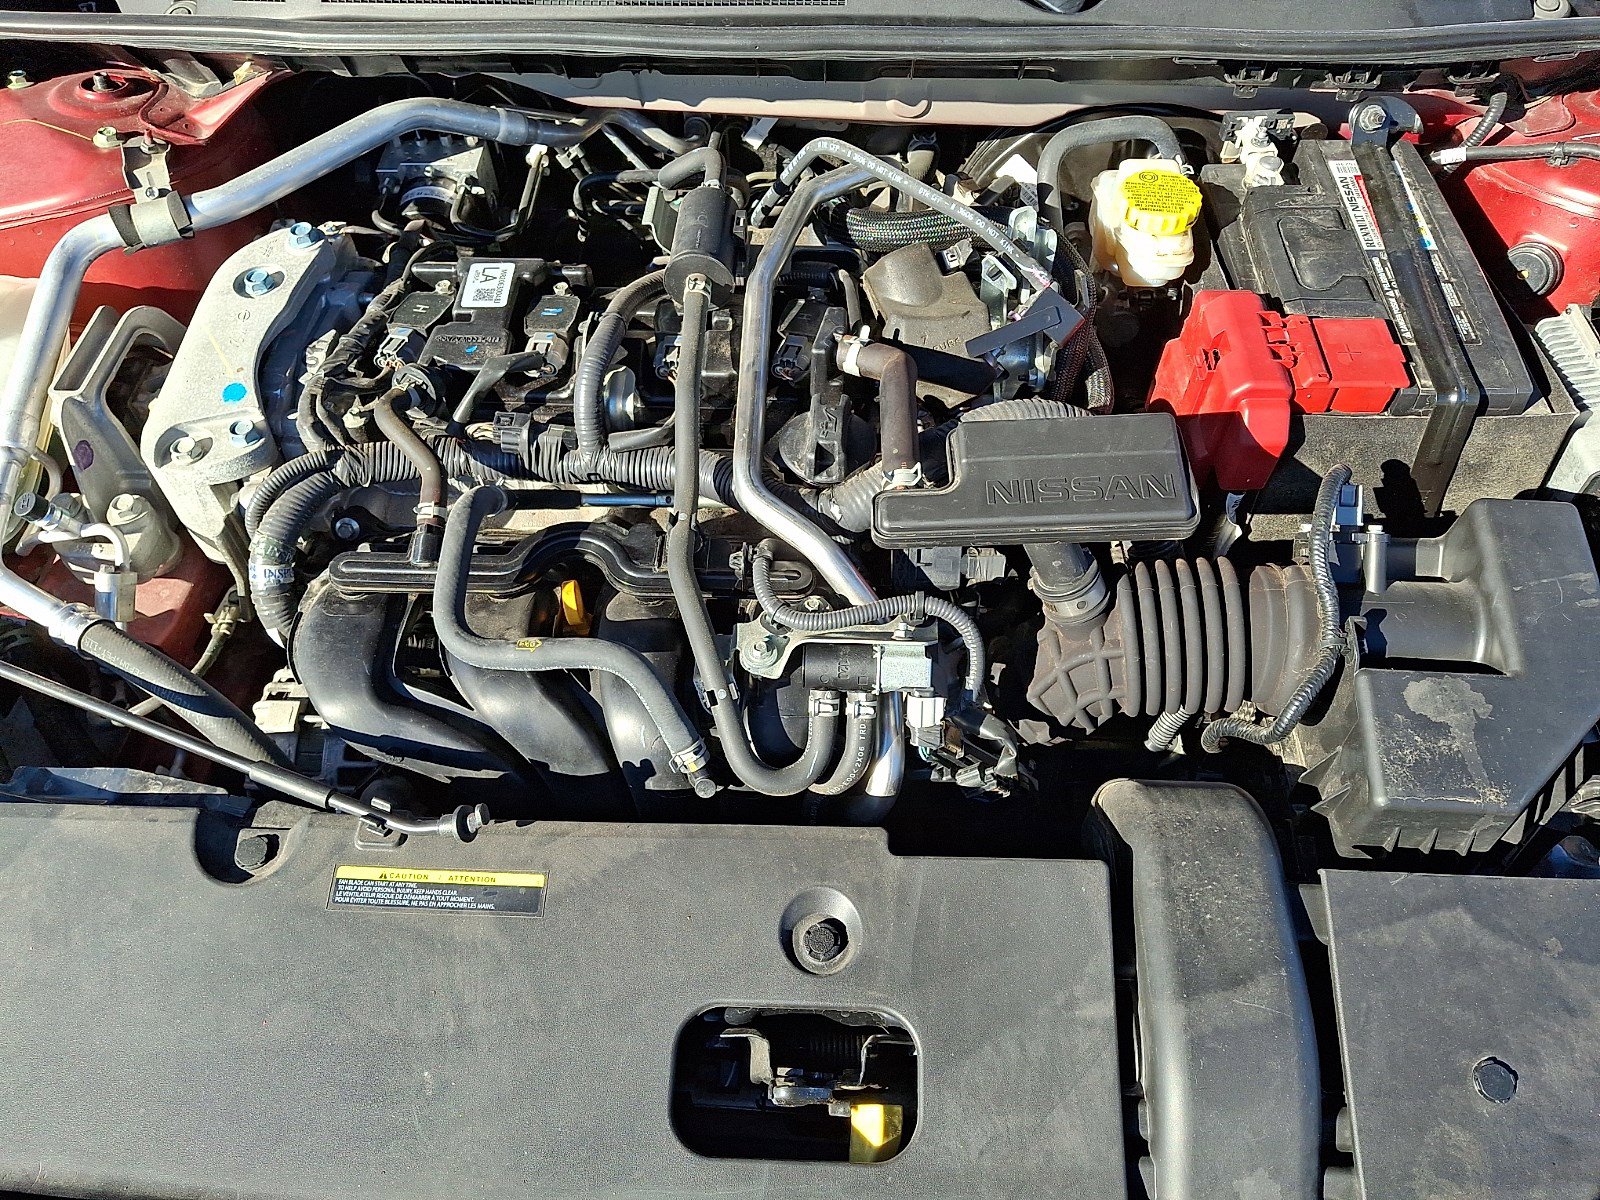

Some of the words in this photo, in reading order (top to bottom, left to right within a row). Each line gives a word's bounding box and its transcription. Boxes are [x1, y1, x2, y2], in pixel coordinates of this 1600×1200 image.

[1338, 176, 1362, 212] NISSAN
[1354, 213, 1376, 248] RENAULT
[480, 267, 500, 284] LA
[985, 473, 1177, 505] NISSAN
[389, 872, 429, 880] CAUTION
[448, 875, 496, 883] ATTENTION
